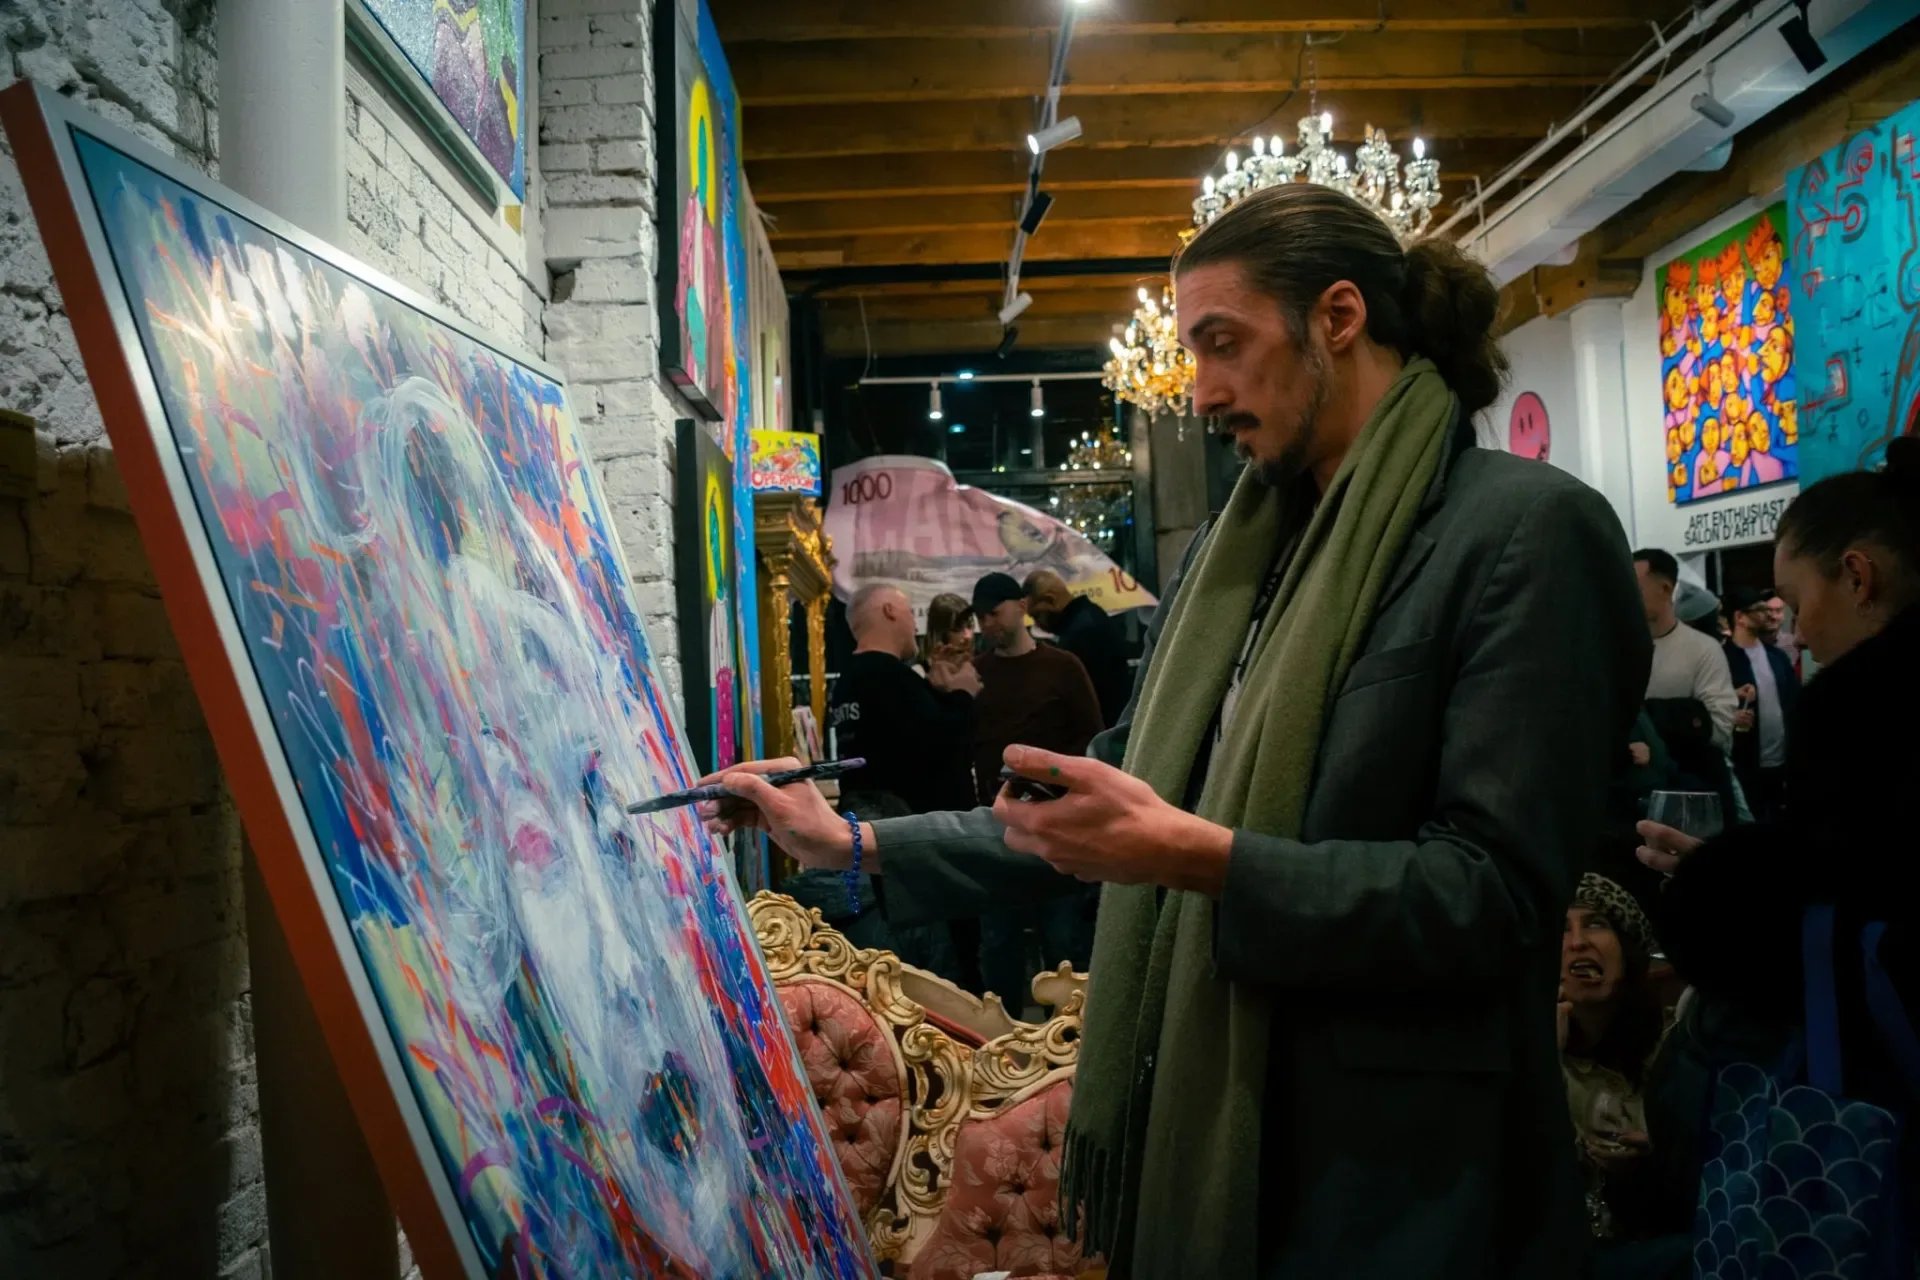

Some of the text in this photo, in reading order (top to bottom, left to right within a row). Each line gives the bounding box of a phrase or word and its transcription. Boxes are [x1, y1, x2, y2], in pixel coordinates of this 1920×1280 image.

[841, 472, 893, 506] 1000
[1690, 499, 1784, 529] ART ENTHUSIAST
[1684, 526, 1720, 546] SALON
[1723, 518, 1756, 540] D'ART
